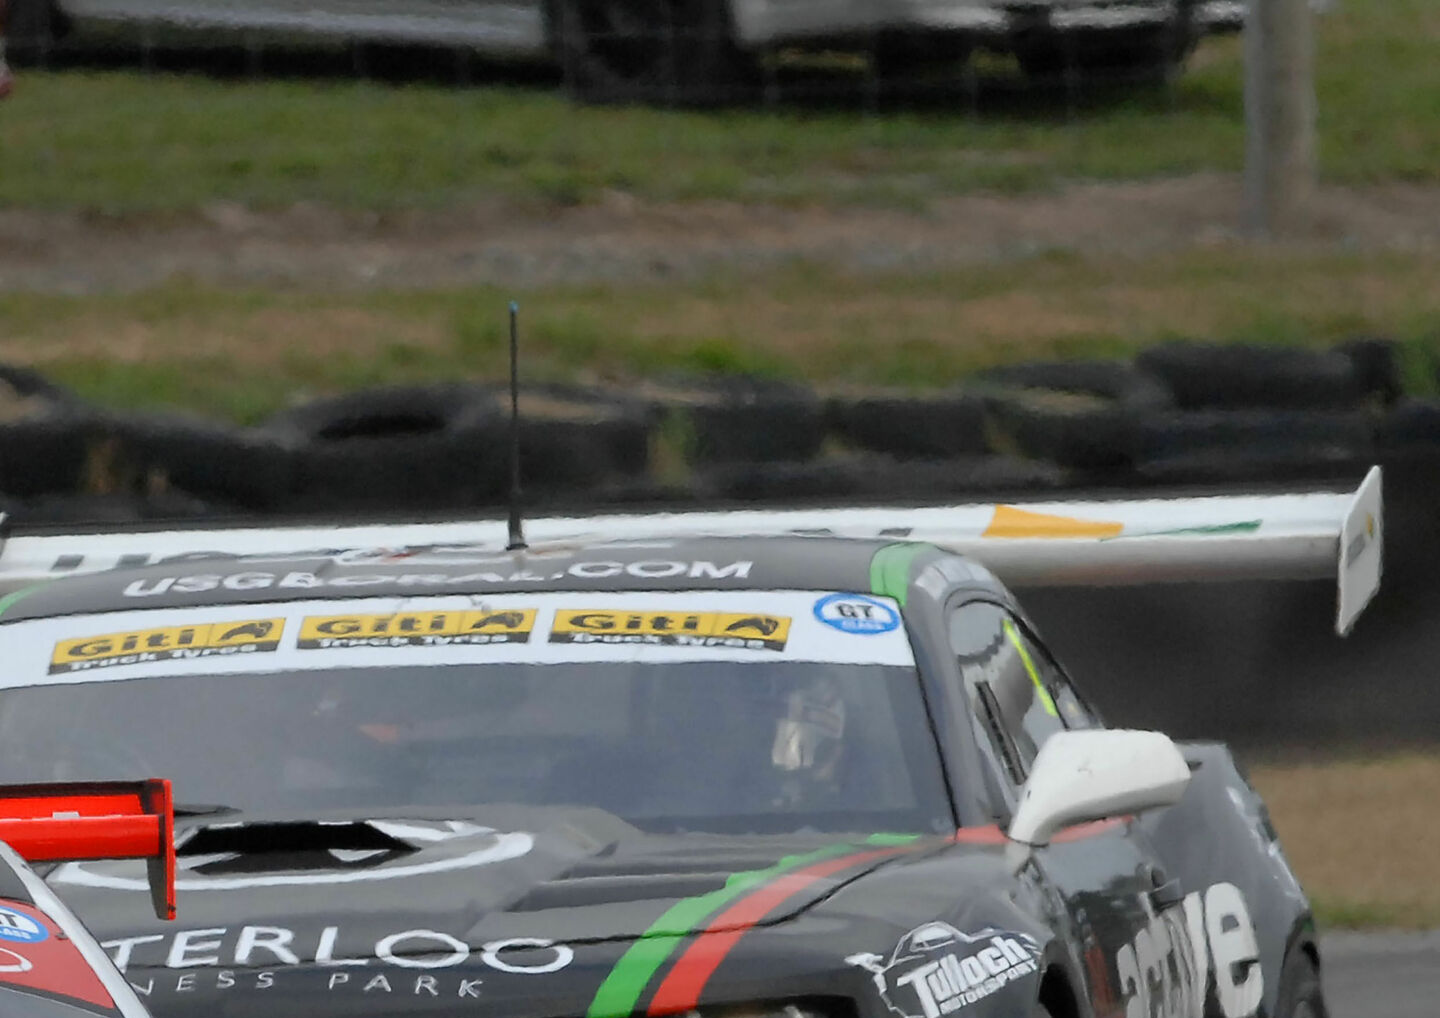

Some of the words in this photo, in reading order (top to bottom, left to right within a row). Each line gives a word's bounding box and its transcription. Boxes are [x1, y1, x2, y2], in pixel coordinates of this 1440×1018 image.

[835, 602, 877, 619] GT
[316, 615, 446, 634] Giti
[569, 614, 700, 630] Giti
[68, 628, 195, 658] Giti
[328, 972, 483, 998] PARK
